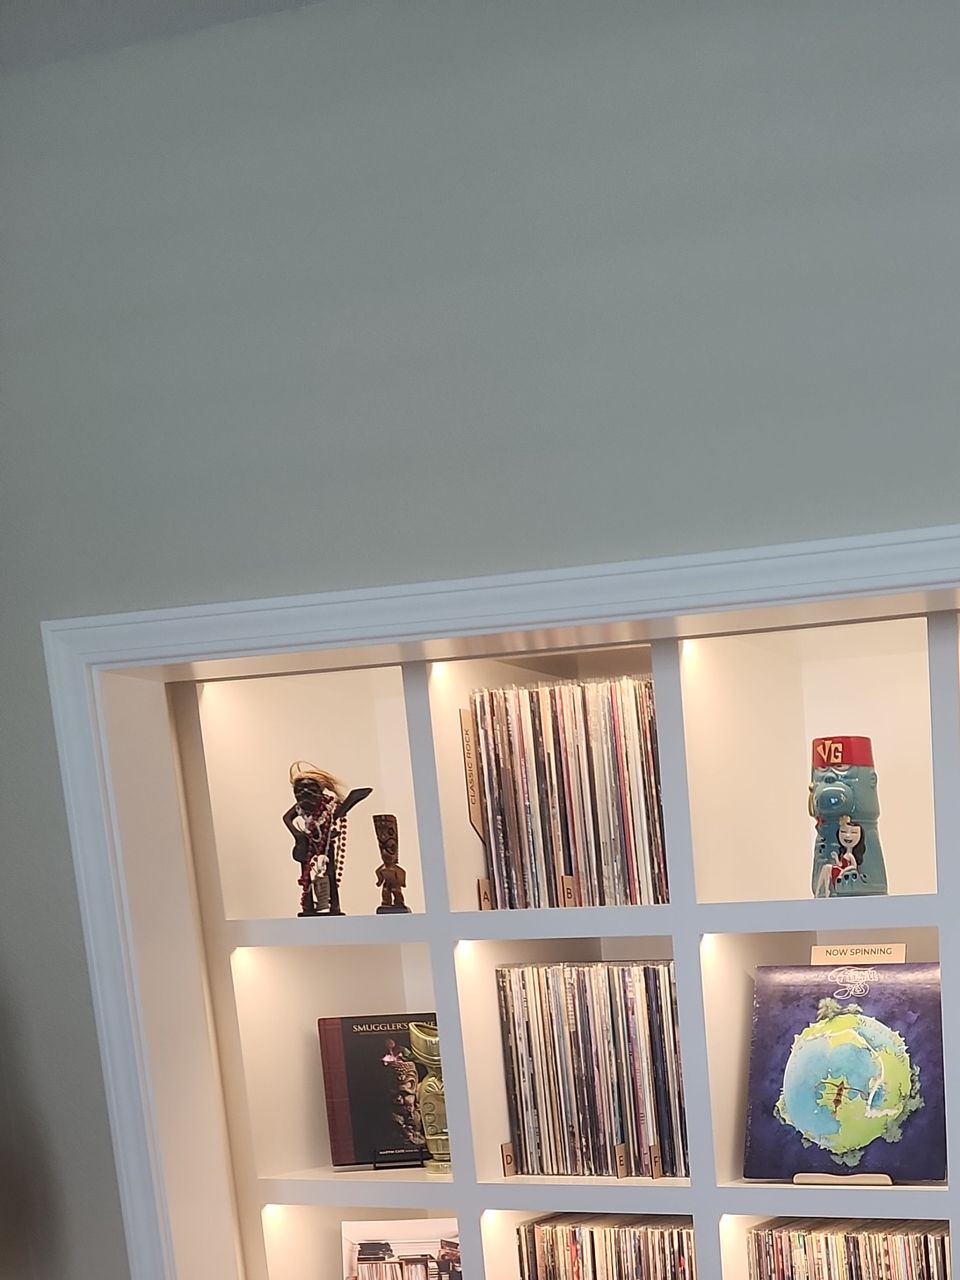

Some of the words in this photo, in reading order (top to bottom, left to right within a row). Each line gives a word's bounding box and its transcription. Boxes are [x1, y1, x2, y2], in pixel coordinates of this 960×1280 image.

[464, 729, 472, 759] ROCK
[816, 740, 843, 763] VG
[466, 763, 477, 805] CLASSIC
[483, 891, 490, 902] A
[566, 887, 573, 899] B
[849, 947, 893, 956] SPINNING
[353, 1022, 409, 1032] SMUGGLER'S
[506, 1154, 513, 1166] D
[618, 1155, 624, 1167] E
[653, 1155, 659, 1167] F
